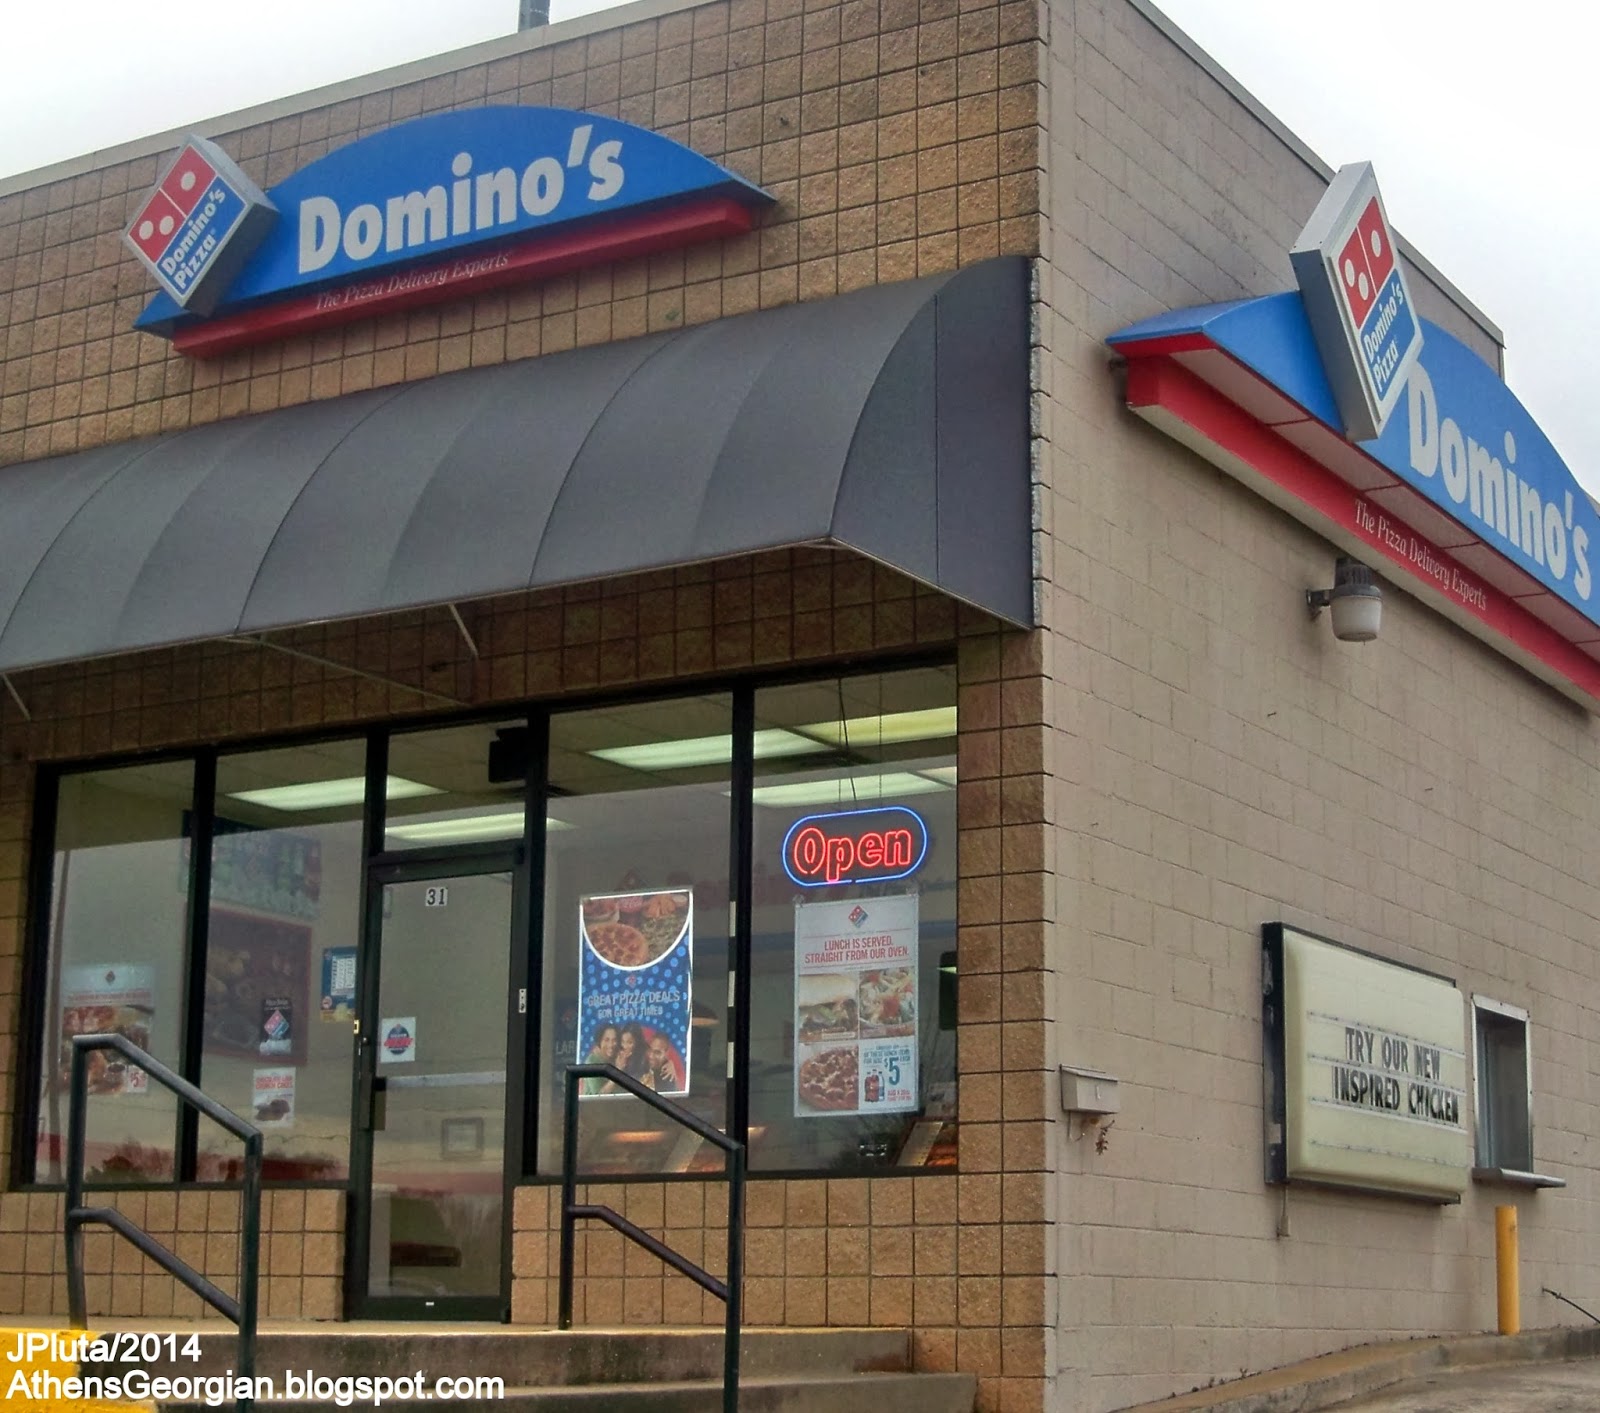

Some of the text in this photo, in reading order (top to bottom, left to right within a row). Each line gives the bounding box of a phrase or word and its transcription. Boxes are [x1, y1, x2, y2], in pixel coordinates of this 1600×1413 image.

[298, 124, 625, 274] Domino's
[161, 189, 226, 275] Domino's
[173, 234, 217, 289] Pizza
[316, 252, 510, 310] The Pizza Delivery Experts
[1363, 281, 1404, 364] Domino's
[1372, 340, 1399, 393] Pizza
[1407, 359, 1591, 600] Domino's
[1355, 499, 1487, 611] The Pizza Delivery Experts
[793, 827, 912, 883] Open
[427, 888, 445, 906] 31
[804, 951, 844, 964] STRAIGHT
[845, 950, 868, 961] FROM
[869, 948, 886, 960] OUR
[824, 939, 850, 951] LUNCH
[852, 938, 860, 949] IS
[588, 990, 680, 1007] GREAT PIZZA DEALS
[884, 1056, 900, 1086] $5
[1345, 1026, 1440, 1081] TRY OUR NEW
[1333, 1066, 1460, 1124] INSPIRED CHICKEN
